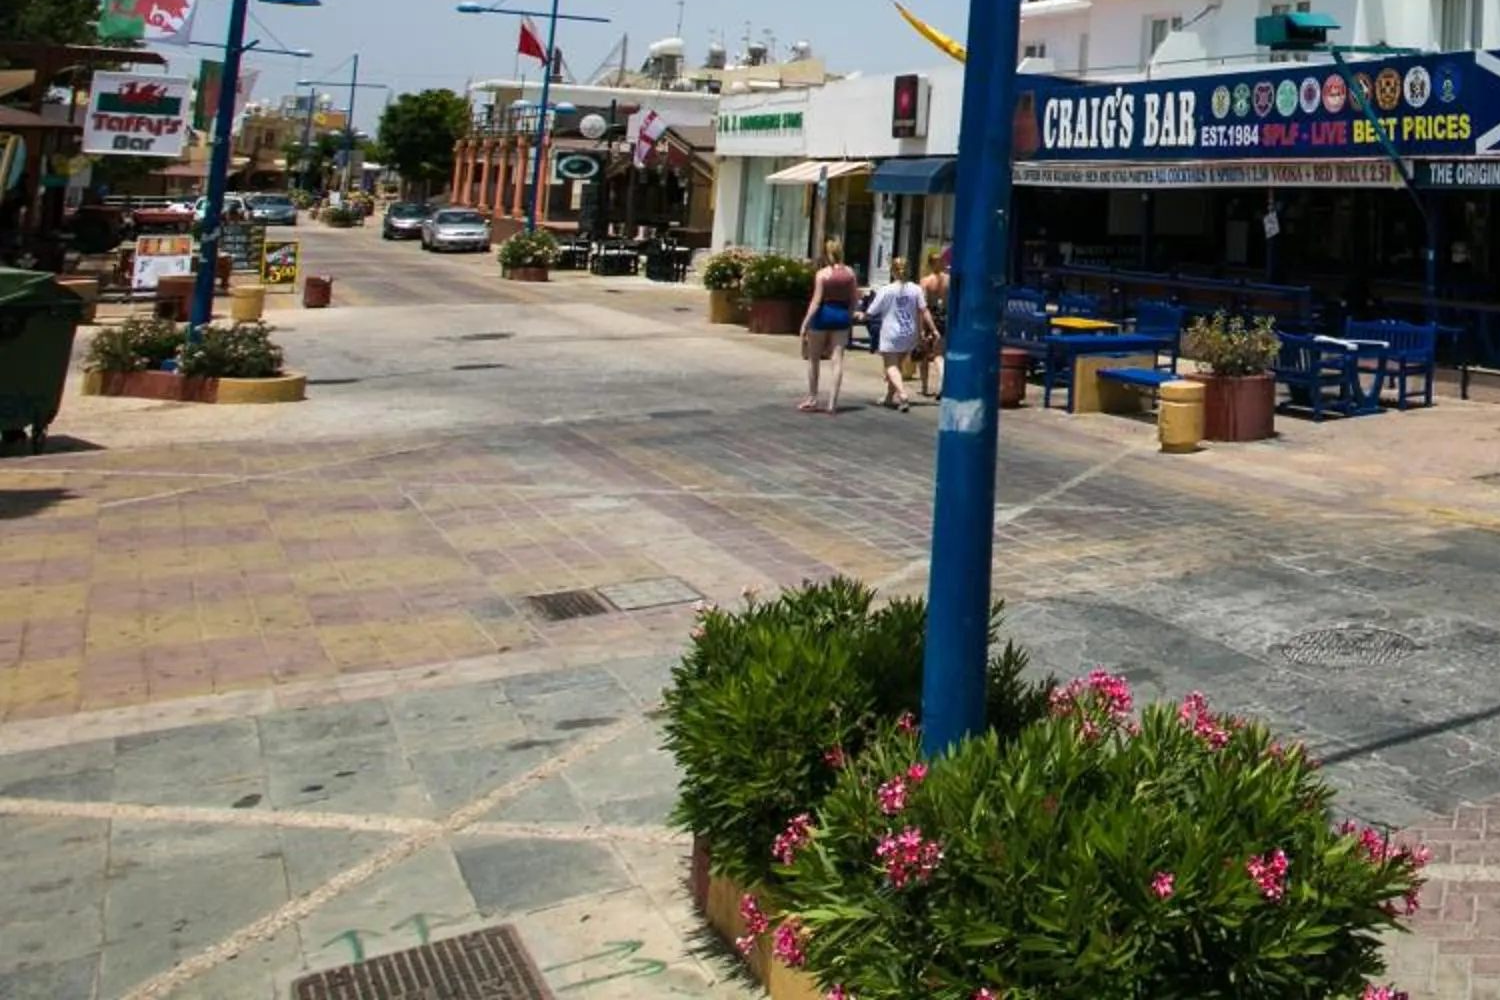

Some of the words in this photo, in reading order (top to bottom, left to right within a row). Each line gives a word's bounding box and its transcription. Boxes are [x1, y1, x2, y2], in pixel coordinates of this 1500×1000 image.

[92, 113, 182, 136] Taffy's
[1043, 87, 1135, 149] CRAIG'S
[1143, 90, 1197, 147] BAR
[1201, 124, 1259, 147] EST.1984
[1311, 120, 1347, 145] LIVE
[1403, 113, 1471, 141] PRICES
[112, 134, 156, 151] Bar
[1313, 165, 1333, 181] RED
[1429, 164, 1454, 184] THE
